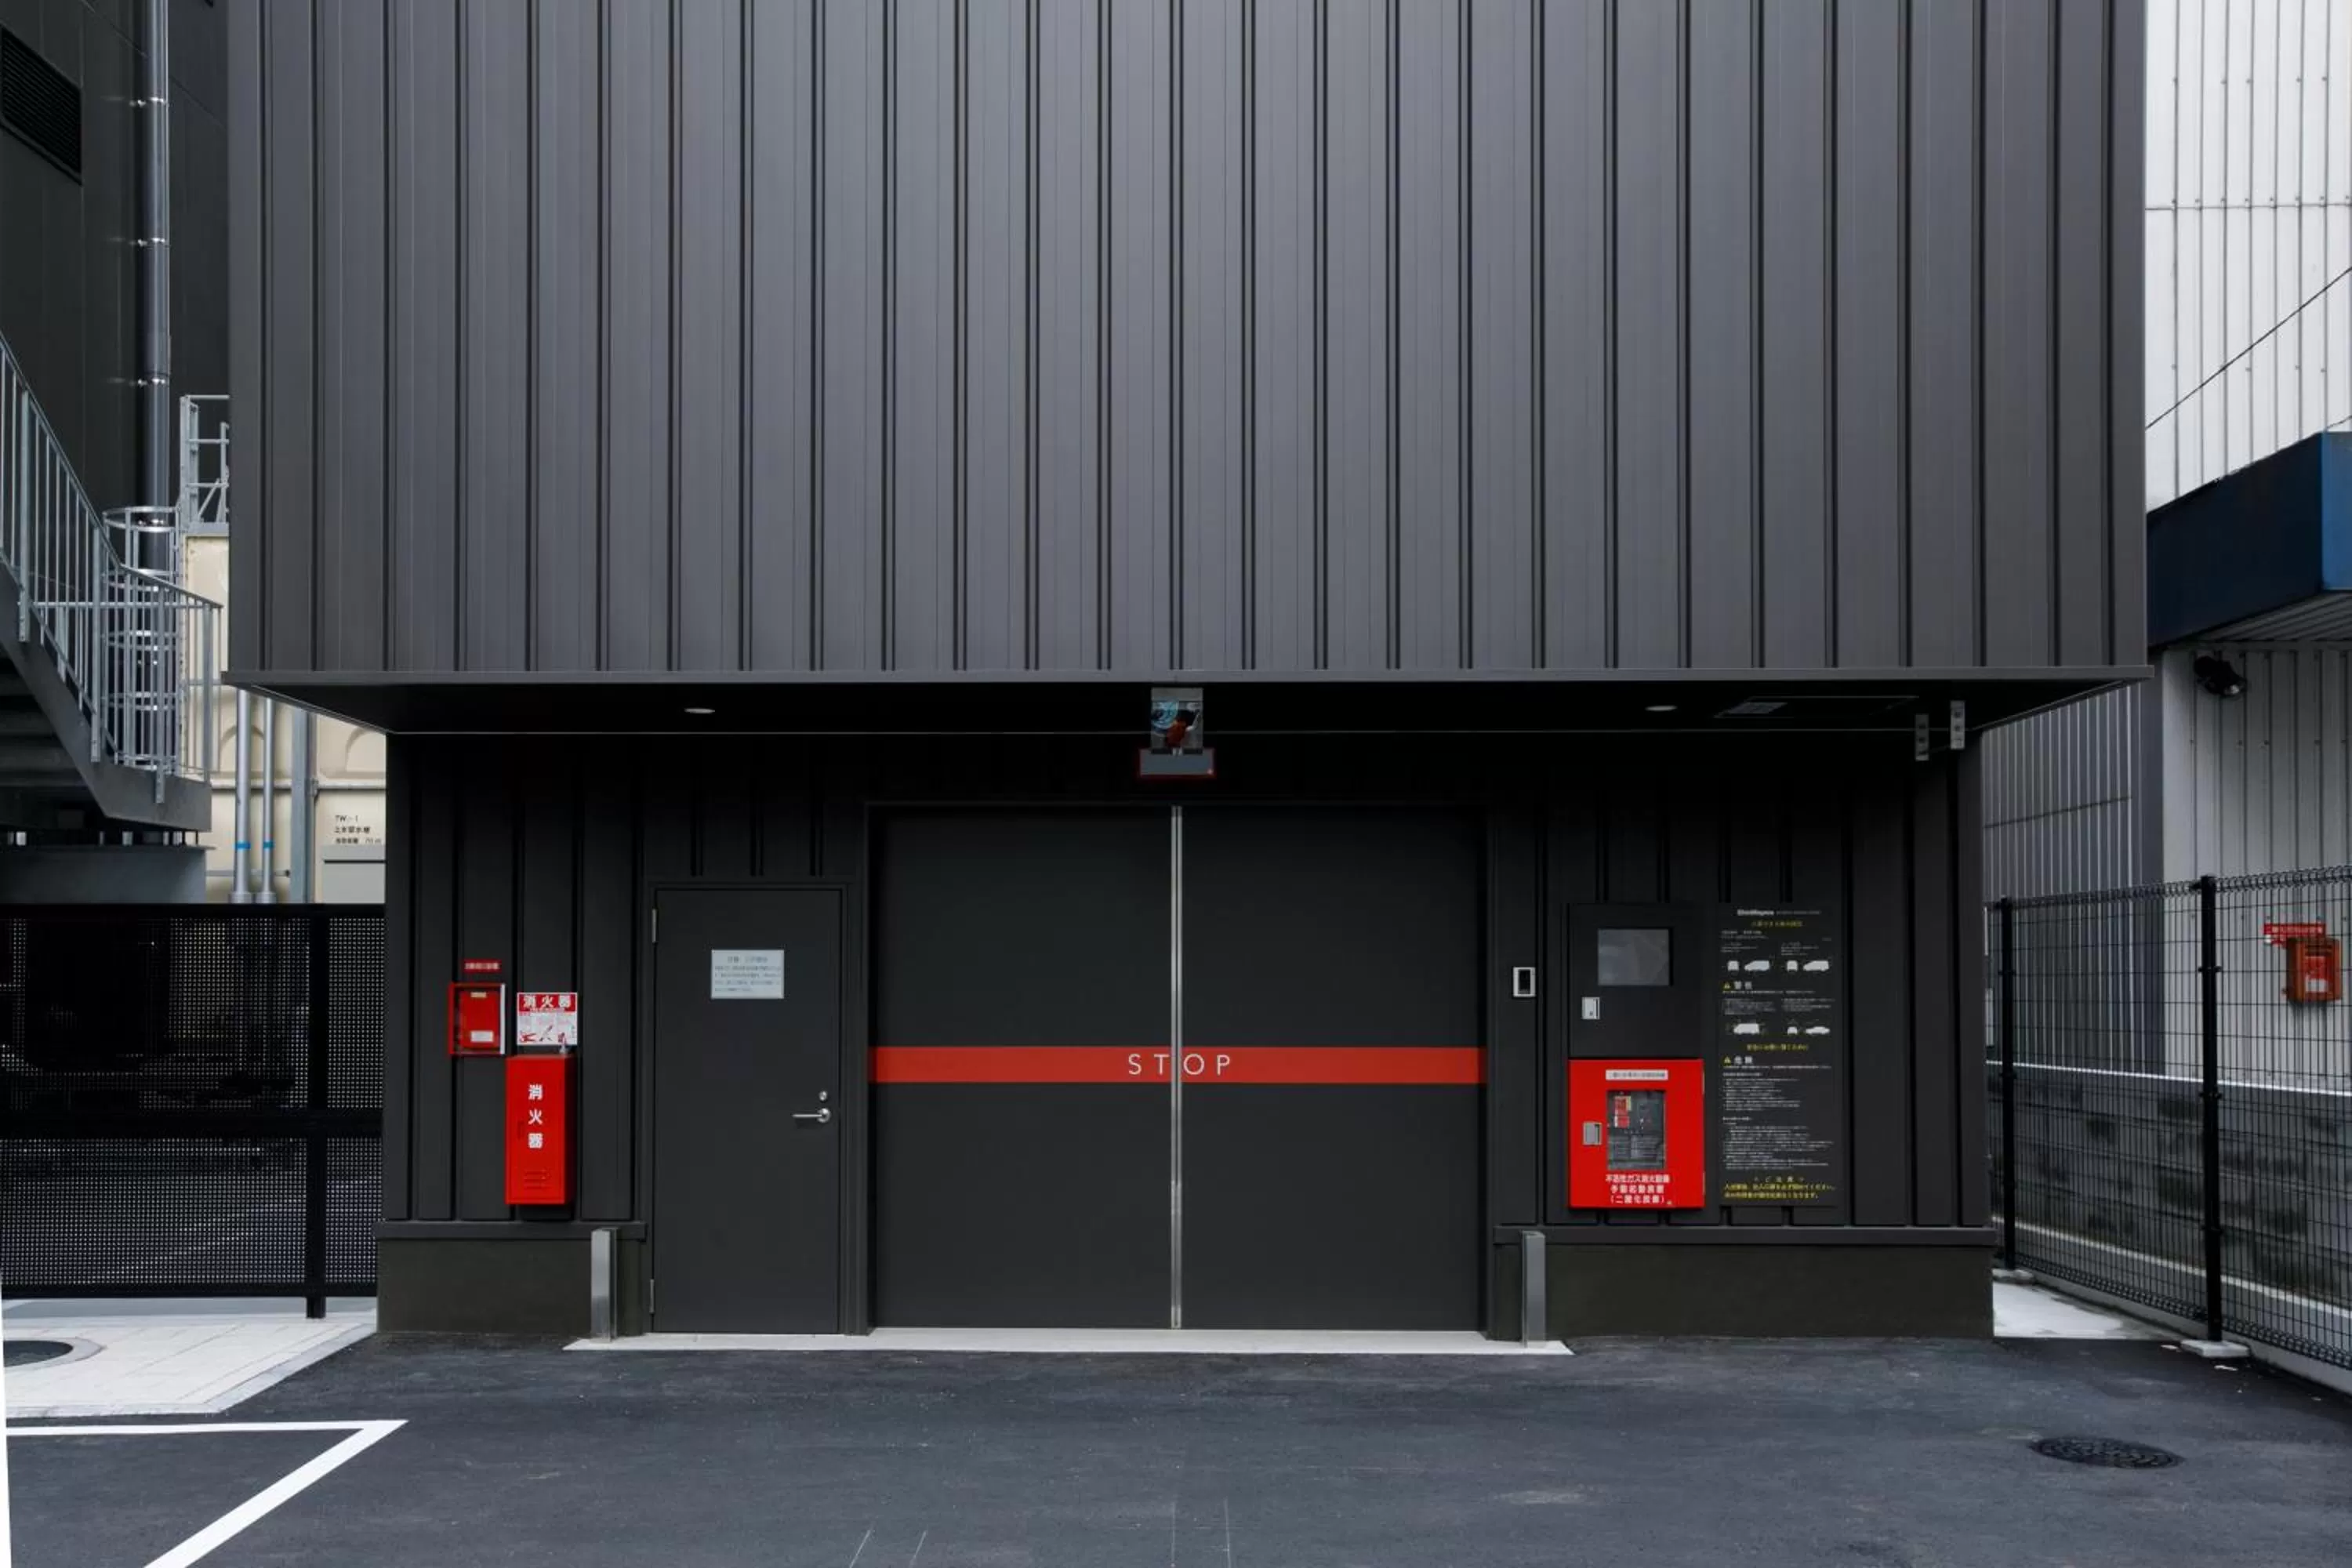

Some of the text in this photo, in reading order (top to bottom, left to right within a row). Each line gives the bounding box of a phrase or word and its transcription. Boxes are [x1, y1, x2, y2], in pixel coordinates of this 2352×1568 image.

[523, 995, 571, 1007] 消火器
[1128, 1053, 1231, 1076] STOP
[528, 1083, 543, 1149] 消火器
